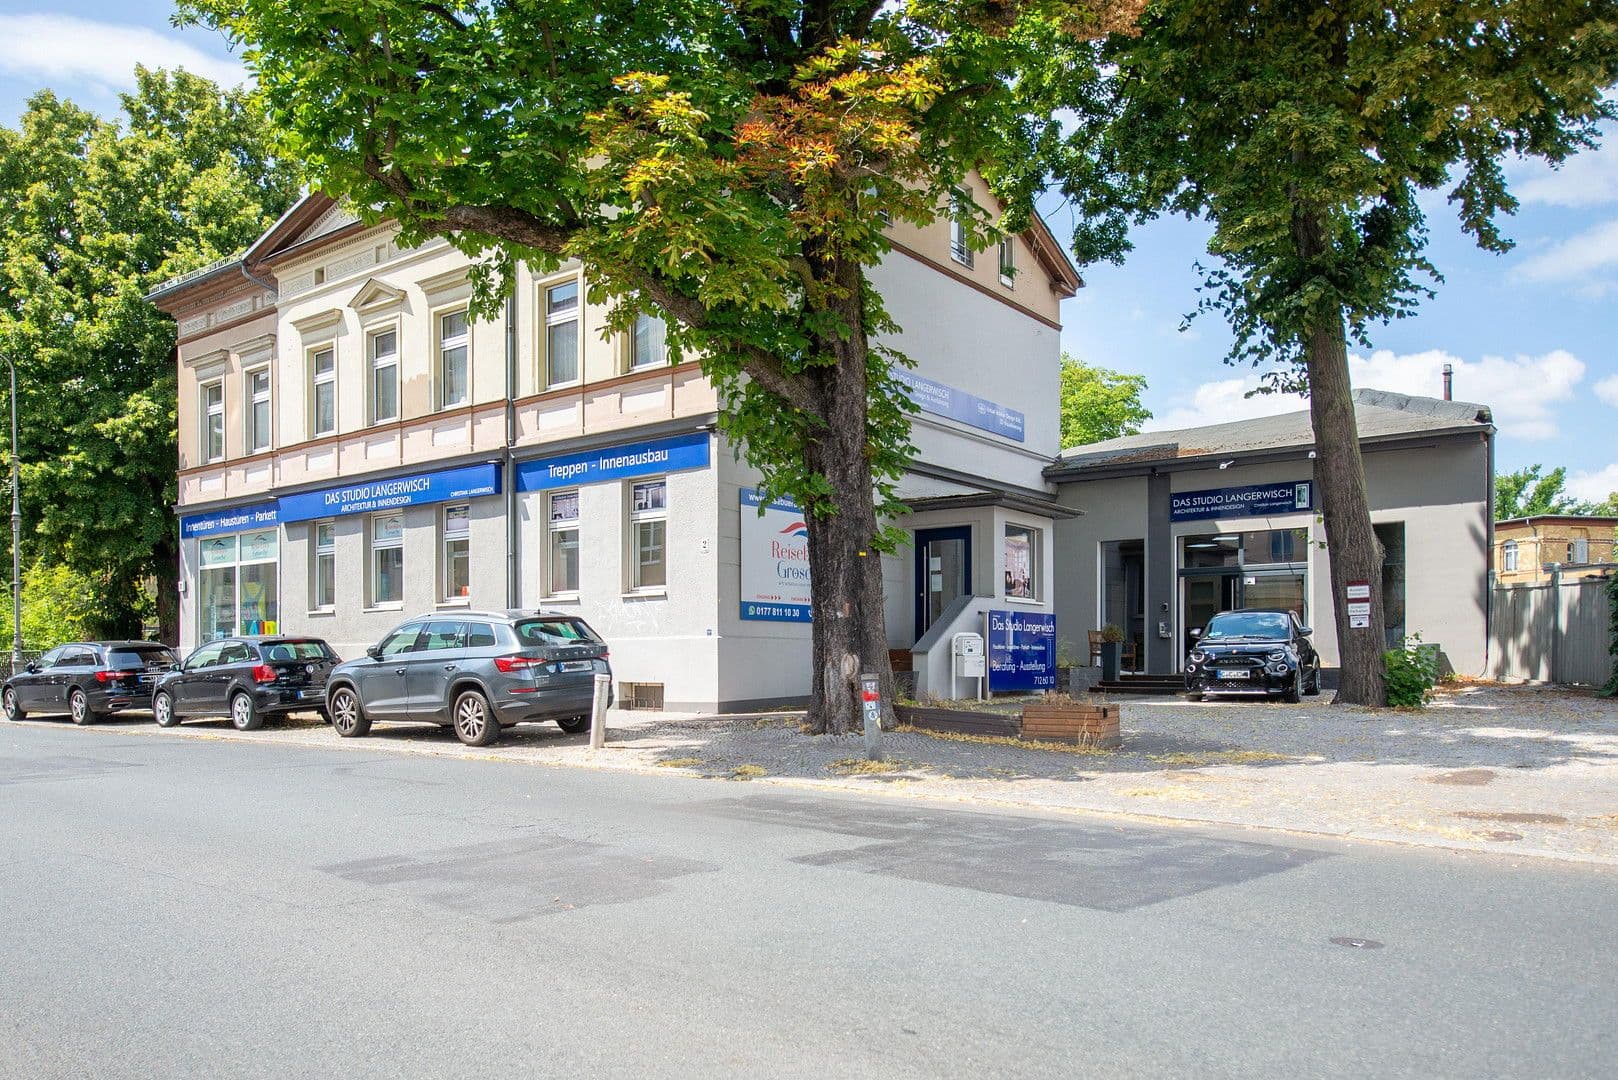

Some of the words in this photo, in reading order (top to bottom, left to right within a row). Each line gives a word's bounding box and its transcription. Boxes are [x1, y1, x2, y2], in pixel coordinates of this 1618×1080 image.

[548, 462, 588, 479] Treppen
[599, 449, 669, 470] Innenausbau
[325, 492, 340, 505] DAS
[341, 487, 370, 502] STUDIO
[371, 477, 430, 498] LANGERWISCH
[1173, 498, 1191, 508] DAS
[1192, 495, 1224, 506] STUDIO
[1225, 488, 1293, 503] LANGERWISCH
[341, 501, 371, 512] ARCHITEKTUR
[377, 495, 412, 507] INNENDESIGN
[1173, 506, 1205, 515] ARCHITEKTUR
[1210, 503, 1245, 512] INNENDESIGN
[185, 519, 215, 532] Innentüren
[220, 515, 250, 528] Haustüren
[255, 509, 277, 522] Parkett
[756, 606, 771, 616] 0177
[772, 607, 783, 616] 811
[784, 608, 792, 617] 10
[792, 608, 800, 617] 30
[992, 617, 1004, 631] Das
[1005, 618, 1023, 632] Studio
[1023, 619, 1055, 635] Langerwisch
[992, 660, 1016, 674] Beratung
[1019, 660, 1046, 673] Ausstellung
